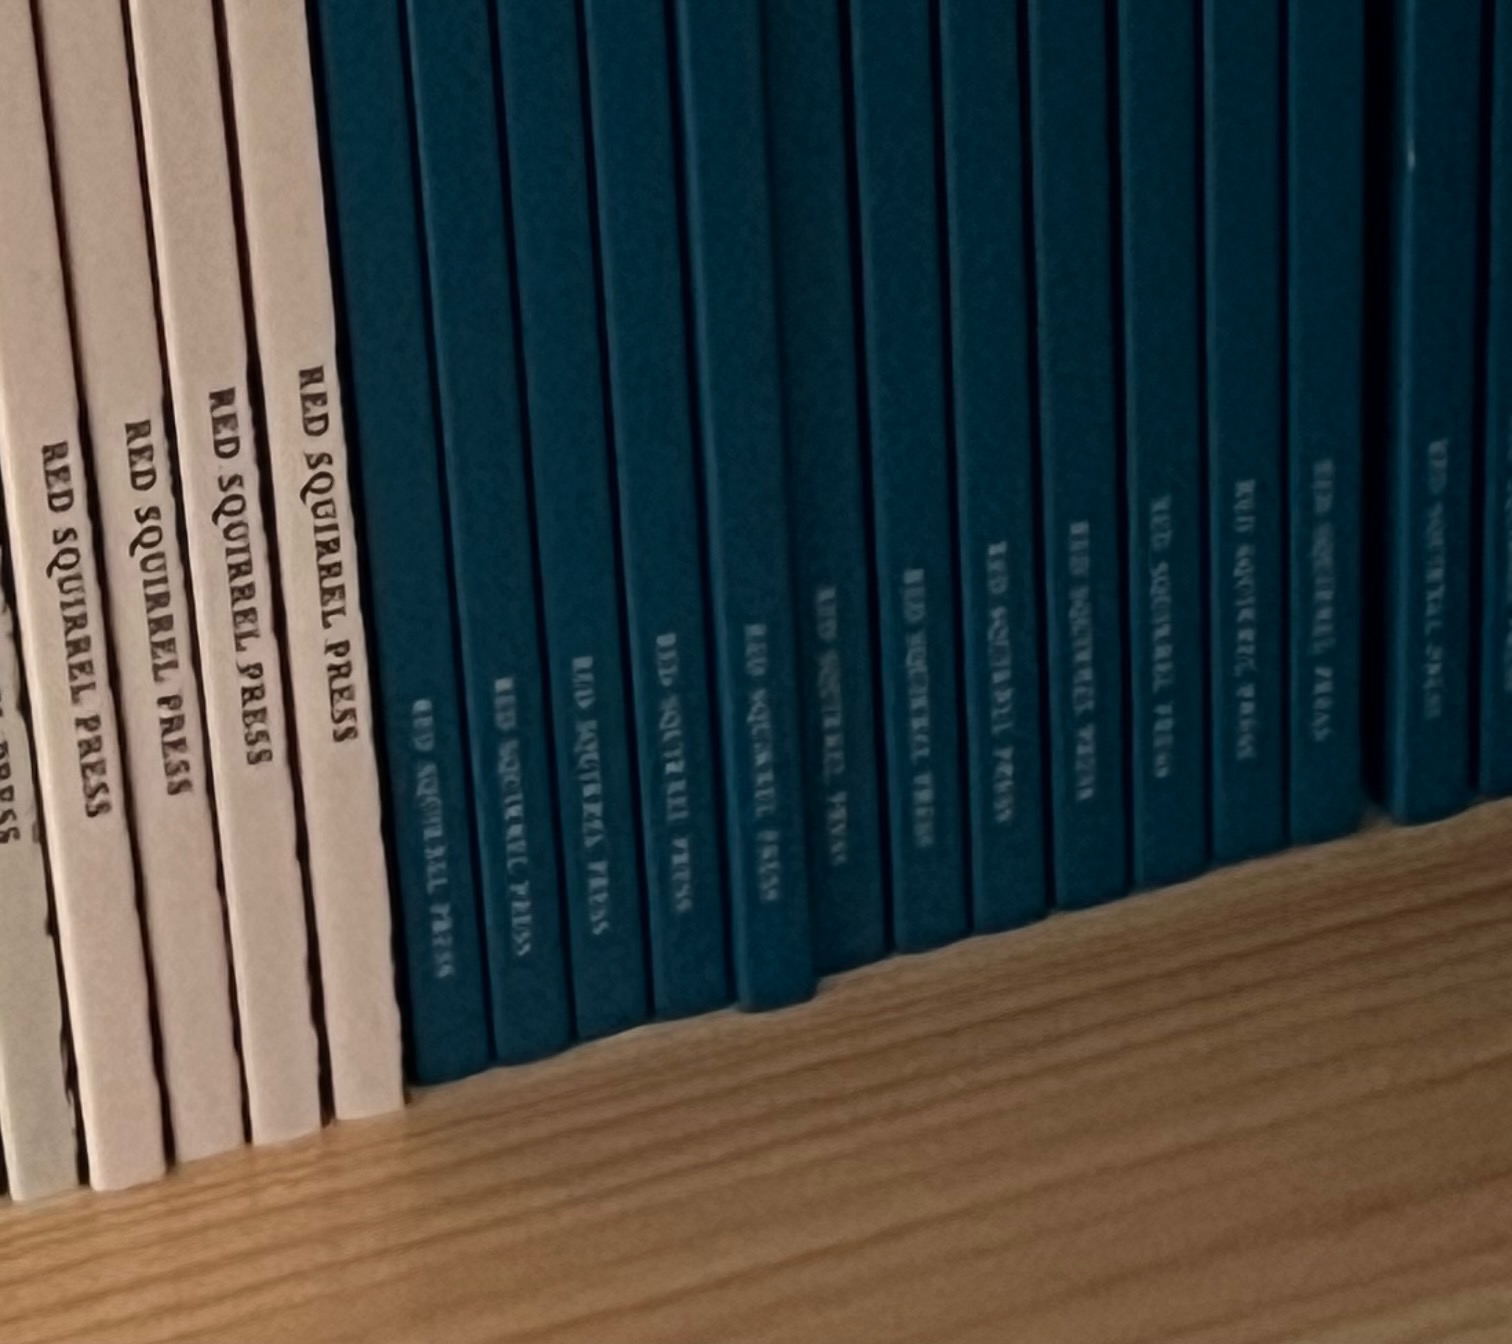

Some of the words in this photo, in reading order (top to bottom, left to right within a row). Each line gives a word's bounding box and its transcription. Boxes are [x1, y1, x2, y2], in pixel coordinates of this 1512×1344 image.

[208, 386, 241, 460] RED
[298, 364, 330, 438] RED
[41, 440, 75, 514] RED
[124, 418, 158, 492] RED
[211, 473, 261, 653] SQUIRREL
[298, 451, 347, 630] SQUIRREL
[45, 527, 97, 705] SQUIRREL
[128, 505, 180, 684] SQUIRREL
[235, 661, 274, 766] PRESS
[323, 639, 359, 743] PRESS
[73, 713, 113, 819] PRESS
[155, 693, 194, 796] PRESS
